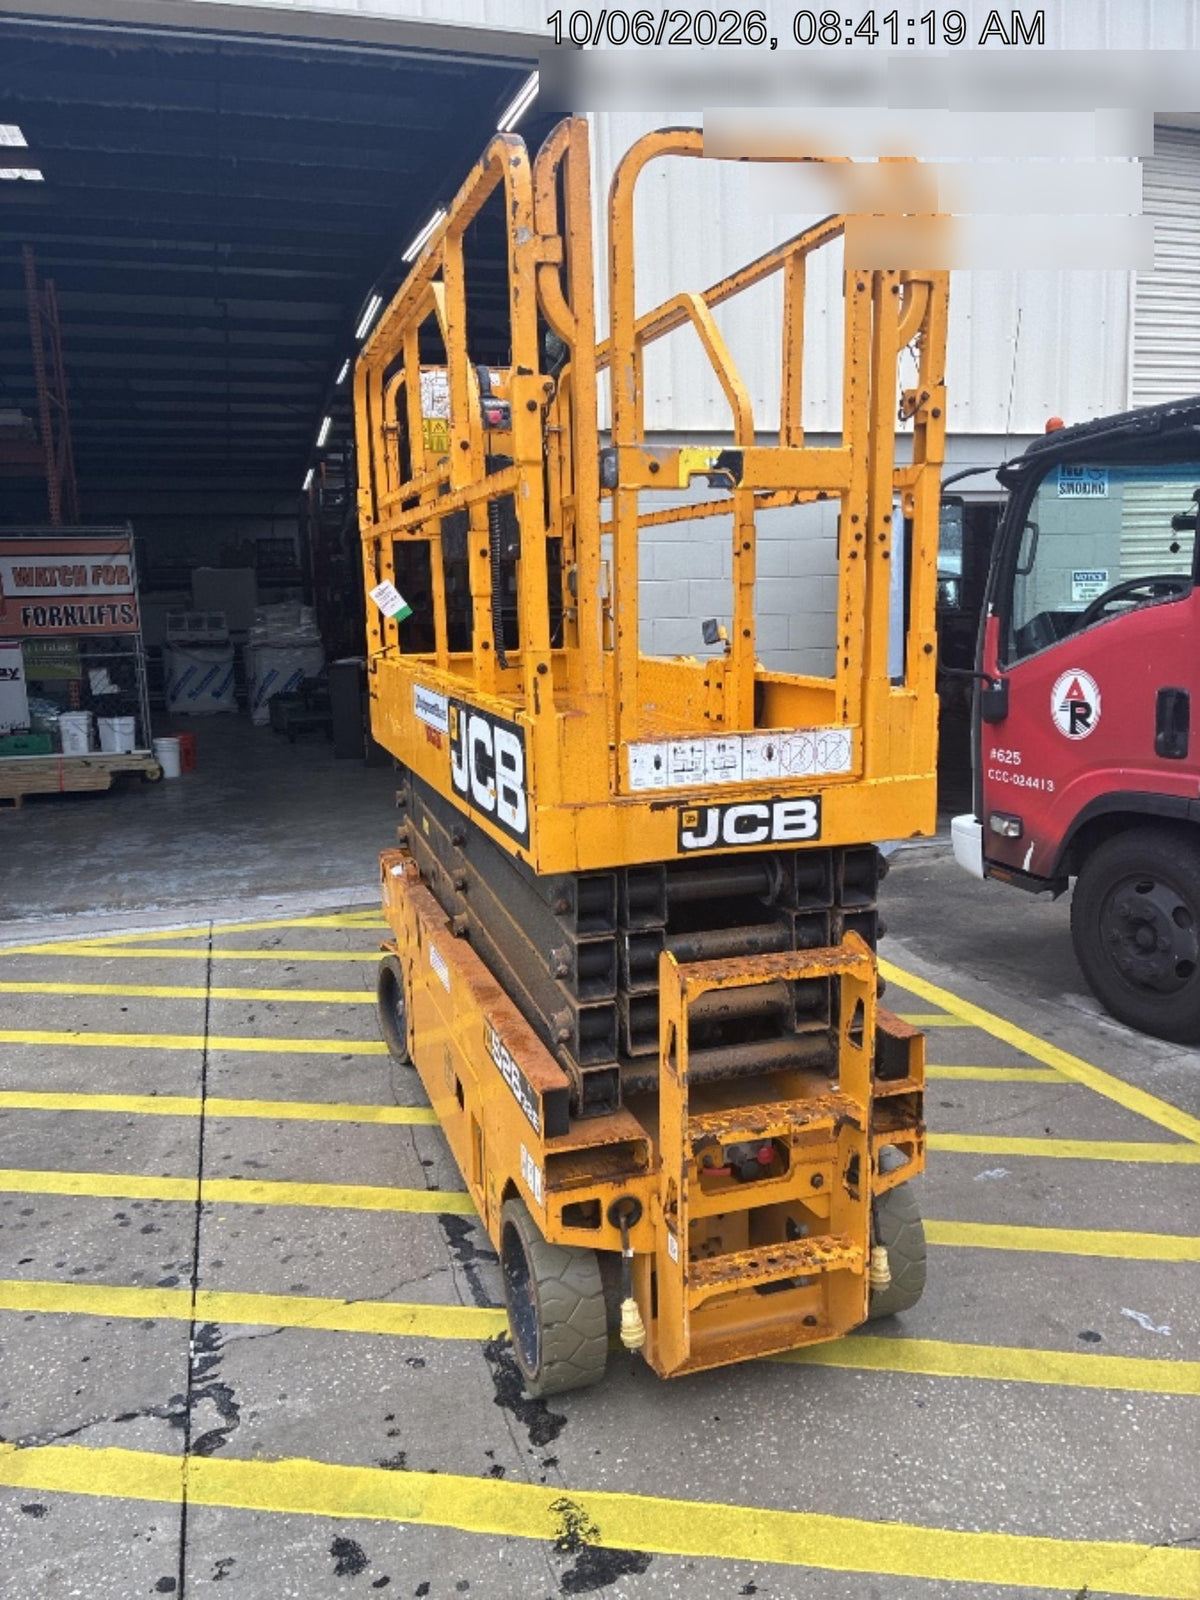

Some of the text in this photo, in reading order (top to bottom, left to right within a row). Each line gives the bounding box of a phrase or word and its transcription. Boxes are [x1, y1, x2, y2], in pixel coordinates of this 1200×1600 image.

[1059, 481, 1105, 495] SMOKING
[11, 565, 130, 588] WATCH FOR
[21, 604, 134, 628] FORKLIFTS
[990, 748, 1022, 765] #625
[452, 709, 527, 835] JCB
[987, 768, 1055, 792] CCC-024413
[682, 799, 819, 848] JCB
